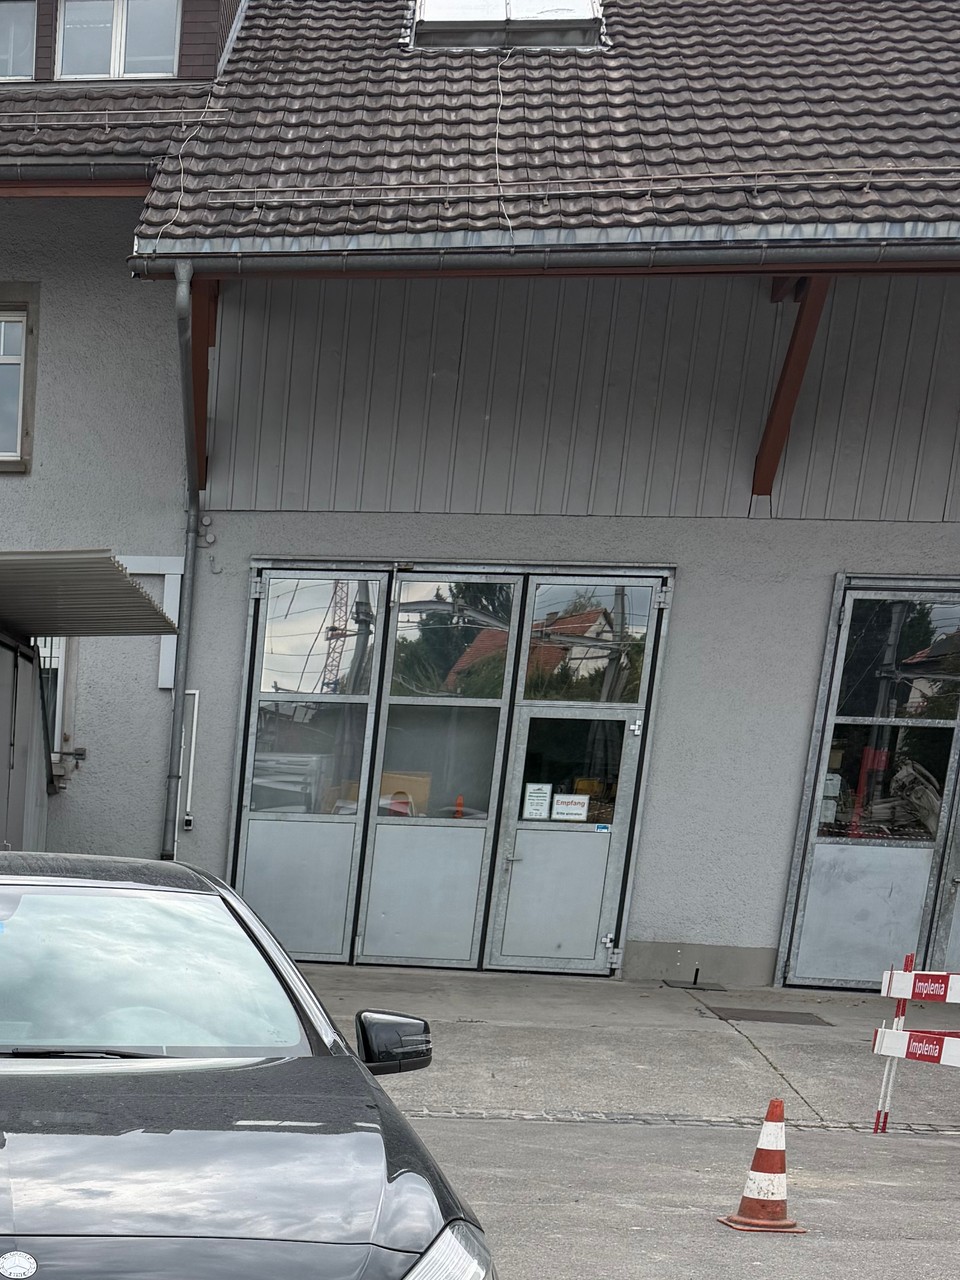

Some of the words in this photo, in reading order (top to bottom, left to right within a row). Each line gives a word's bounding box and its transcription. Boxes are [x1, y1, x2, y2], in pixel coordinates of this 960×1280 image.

[556, 799, 586, 808] Empfang
[914, 978, 946, 998] Implenia
[909, 1038, 940, 1058] Implenia
